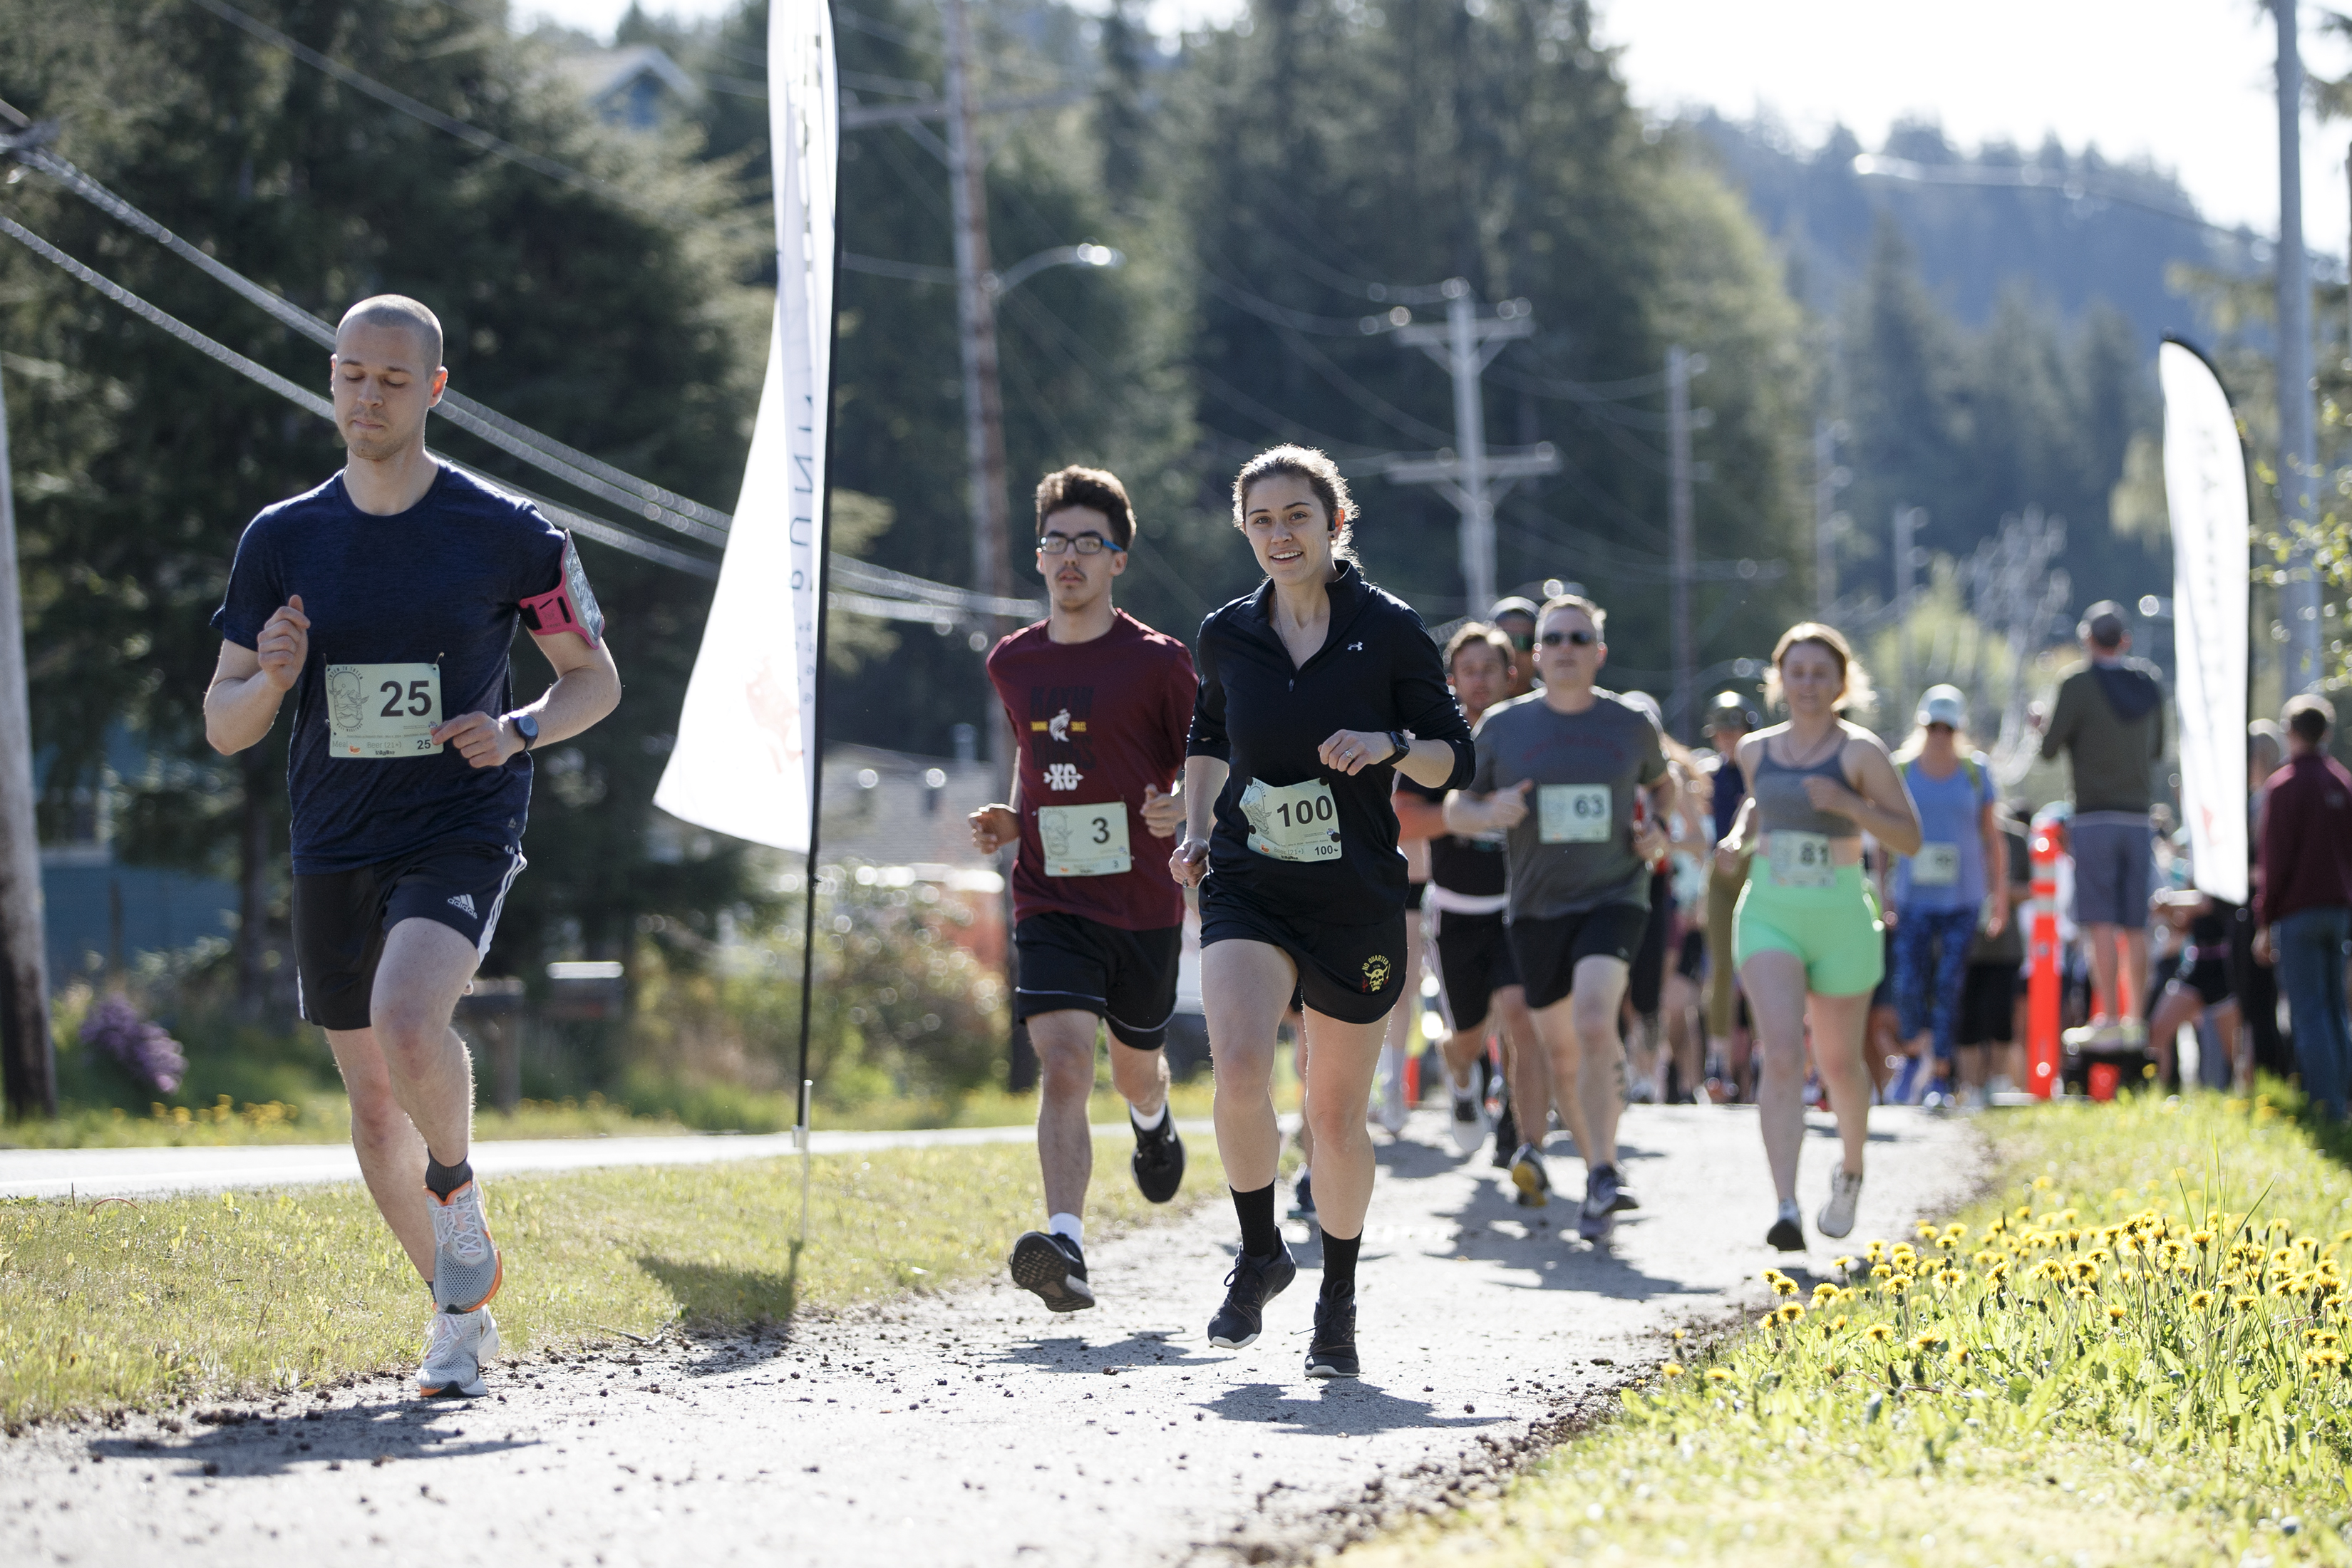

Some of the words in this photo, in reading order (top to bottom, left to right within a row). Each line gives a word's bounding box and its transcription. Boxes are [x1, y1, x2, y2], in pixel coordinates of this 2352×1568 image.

[380, 680, 432, 717] 25
[417, 739, 431, 750] 25
[1049, 763, 1078, 790] XC
[1276, 795, 1333, 827] 100
[1574, 794, 1604, 818] 63
[1091, 817, 1110, 844] 3
[1249, 834, 1262, 845] Meal
[1314, 845, 1334, 855] 100
[1800, 842, 1829, 866] 81
[1113, 860, 1120, 869] 3
[447, 897, 478, 919] adidas
[1362, 962, 1370, 971] NO
[1368, 955, 1389, 966] QUARTER
